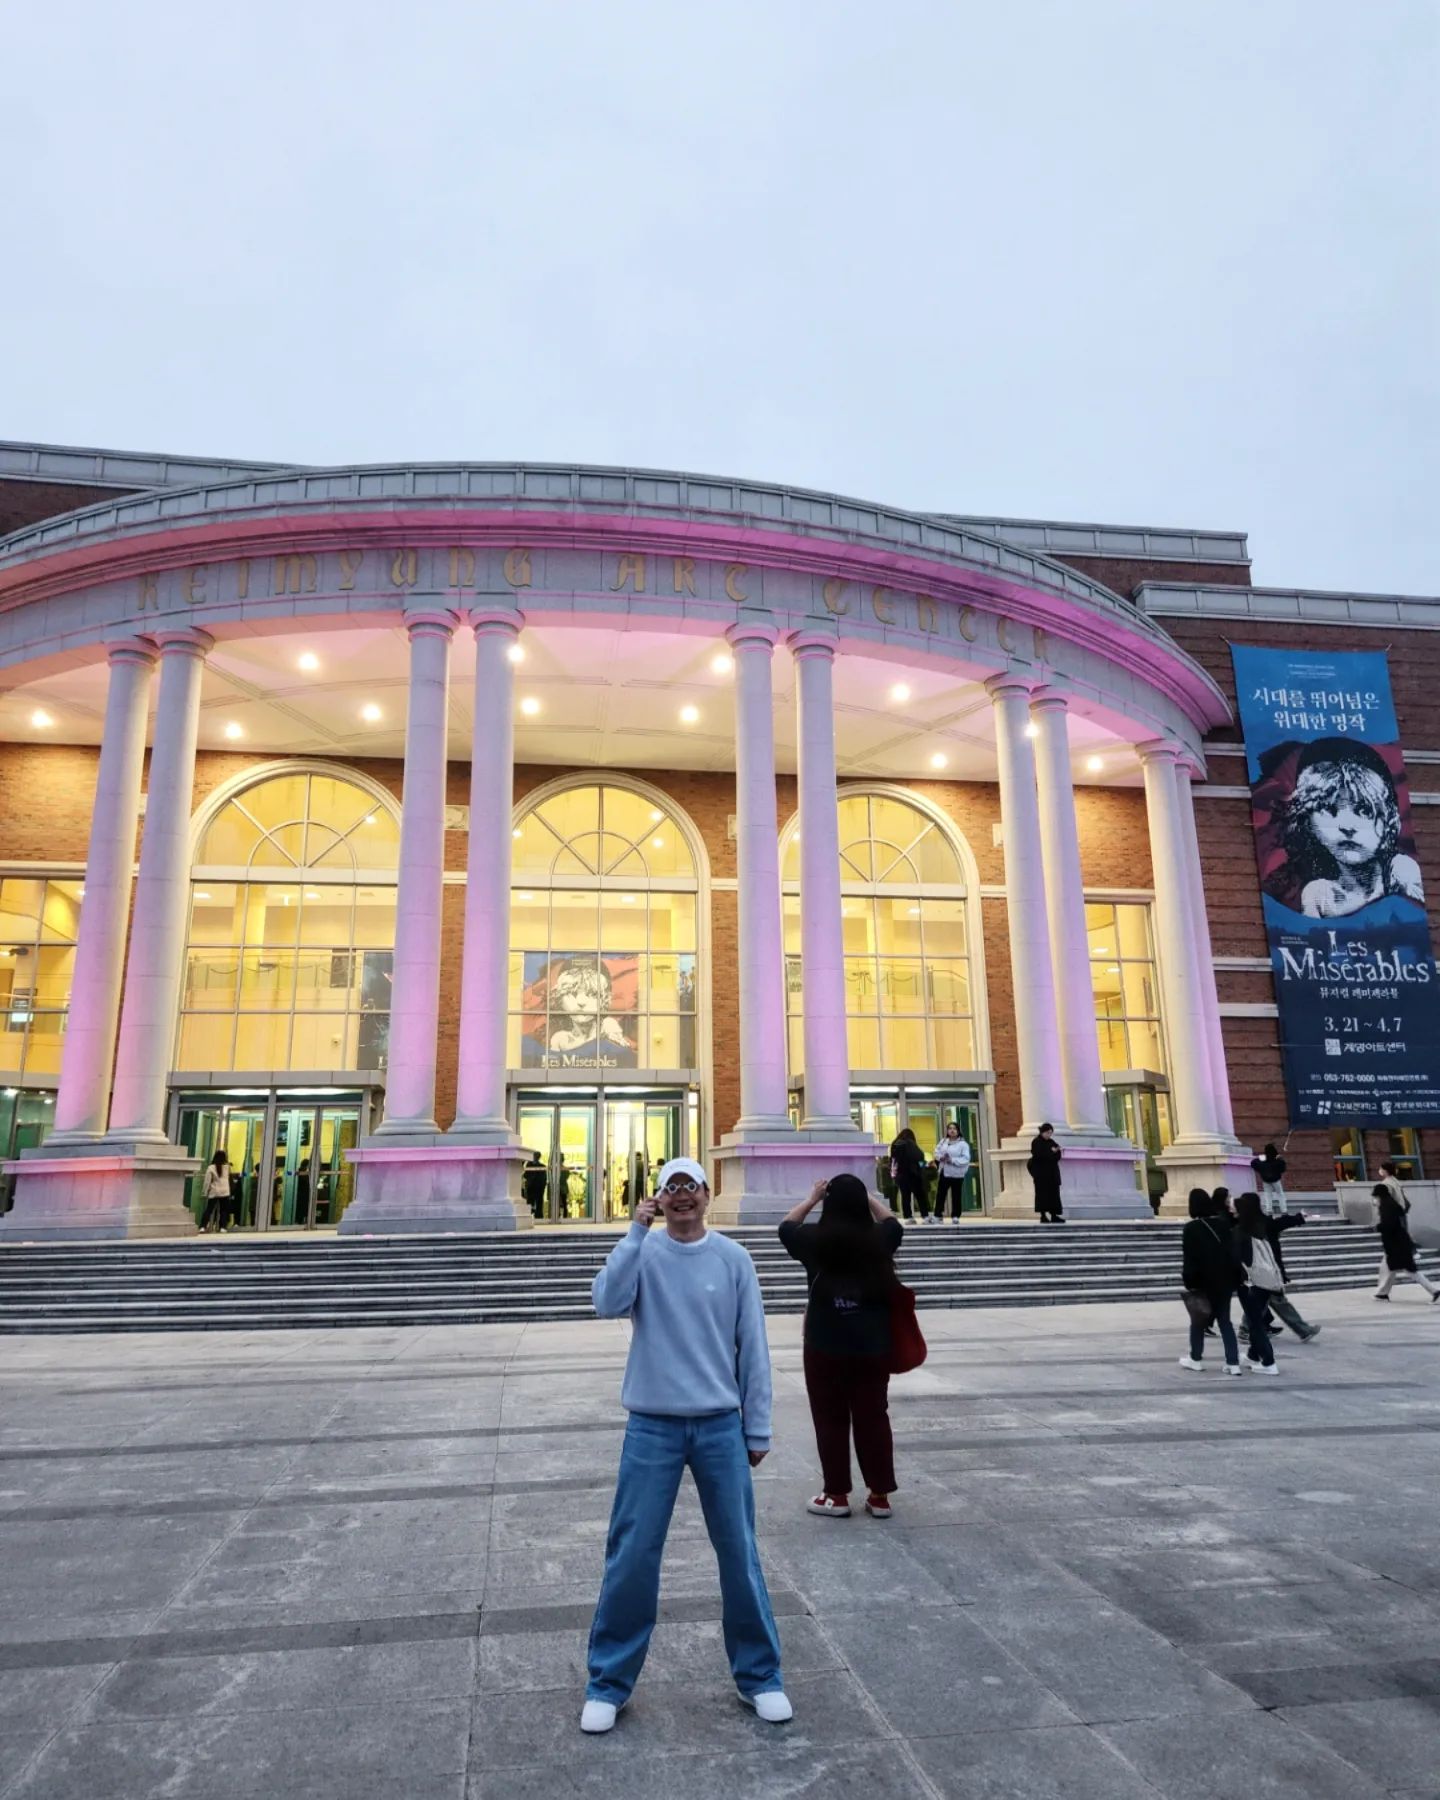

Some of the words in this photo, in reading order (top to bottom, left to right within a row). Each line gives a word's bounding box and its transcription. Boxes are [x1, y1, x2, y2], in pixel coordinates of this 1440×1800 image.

[1253, 687, 1305, 709] 시대를
[1310, 690, 1381, 711] 뛰어넘은
[1274, 710, 1327, 731] 위대한
[1331, 713, 1366, 732] 명작
[1328, 930, 1368, 957] Les
[1277, 947, 1431, 983] Misérables
[1319, 986, 1350, 999] 뮤지컬
[1343, 1041, 1406, 1054] 계명아트센터
